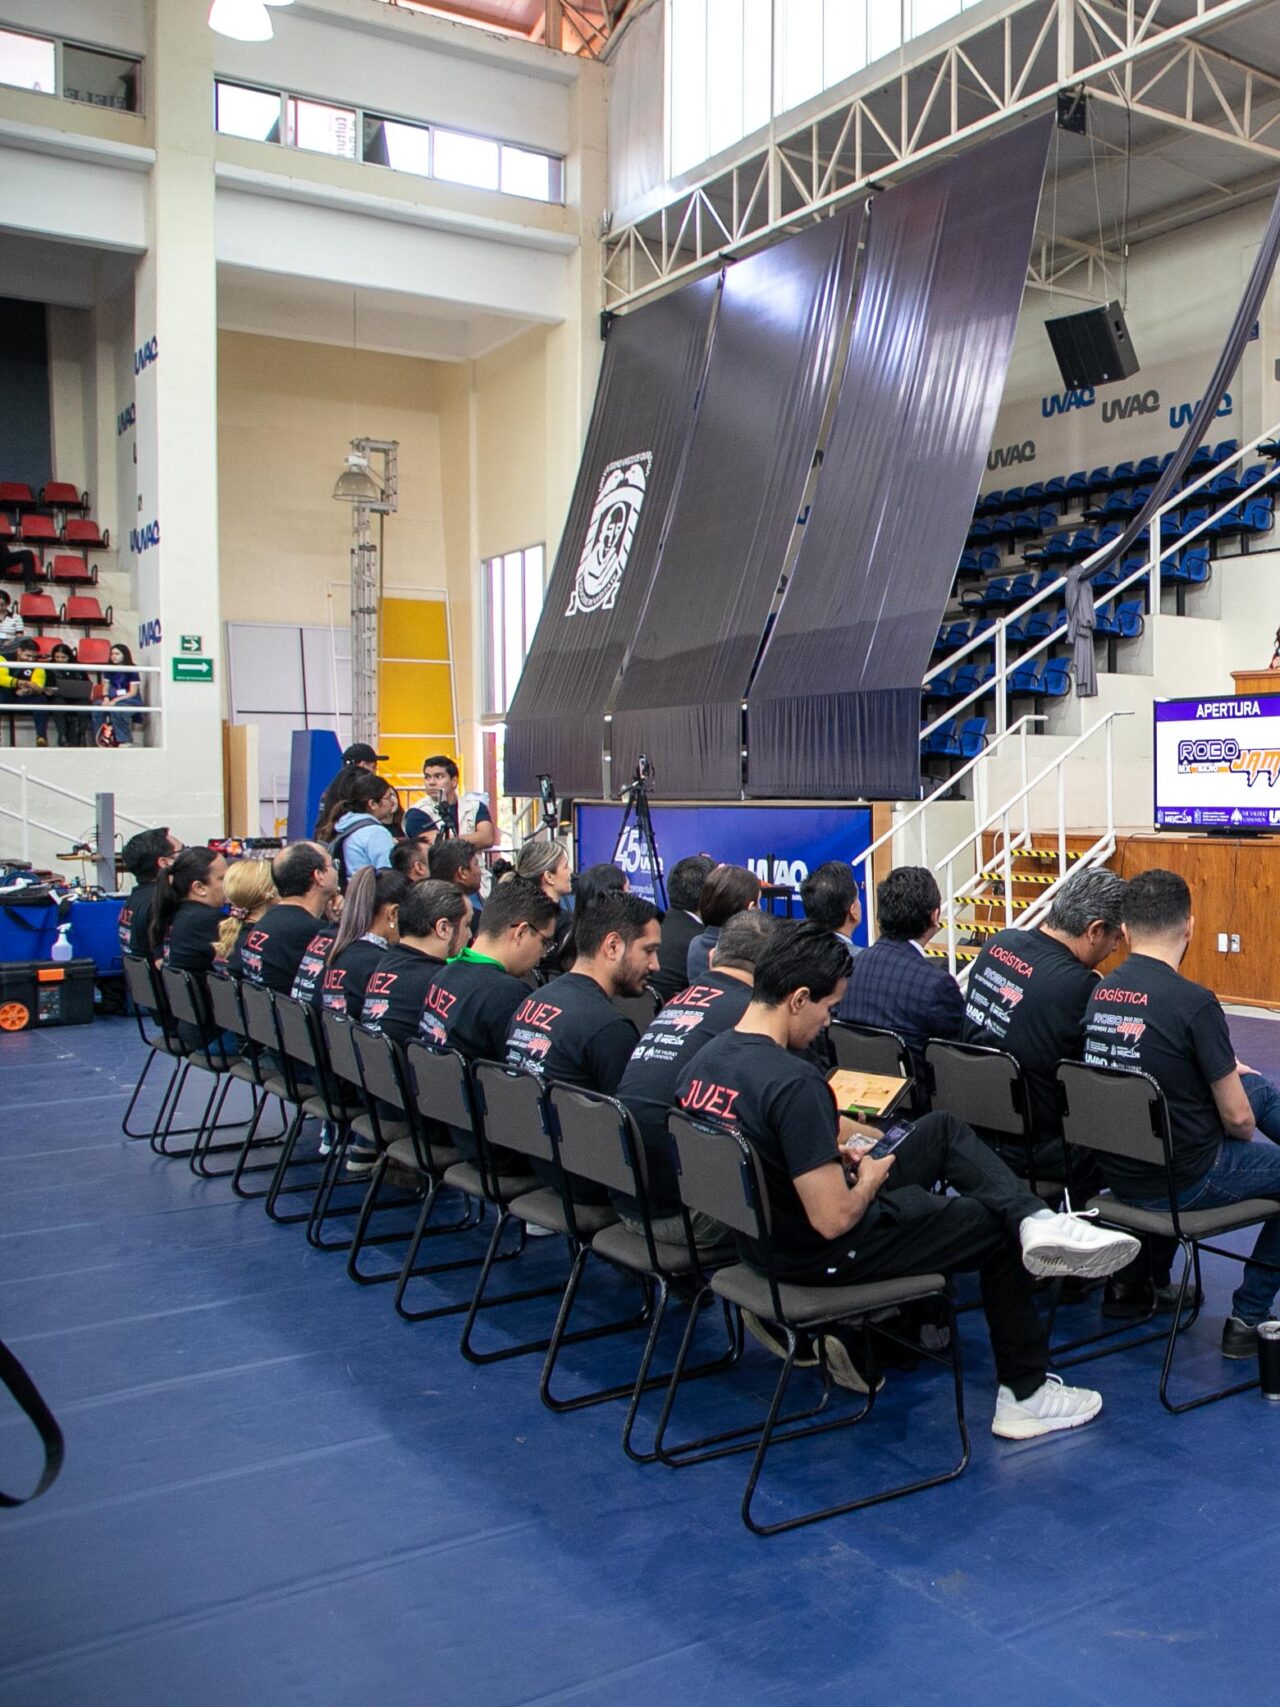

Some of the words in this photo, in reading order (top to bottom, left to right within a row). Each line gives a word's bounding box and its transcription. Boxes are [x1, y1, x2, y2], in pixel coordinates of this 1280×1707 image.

[1041, 386, 1096, 418] UVAQ
[1102, 389, 1160, 423] UVAQ
[1169, 392, 1233, 429] UVQ
[987, 440, 1036, 471] UVAQ
[1196, 701, 1261, 718] APERTURA
[614, 826, 641, 873] 45
[246, 930, 270, 951] EZ
[989, 944, 1034, 978] LOGÍSTICA
[1094, 988, 1148, 1006] LOGÍSTICA
[516, 999, 562, 1031] JUEZ
[681, 1080, 740, 1119] JUEZ
